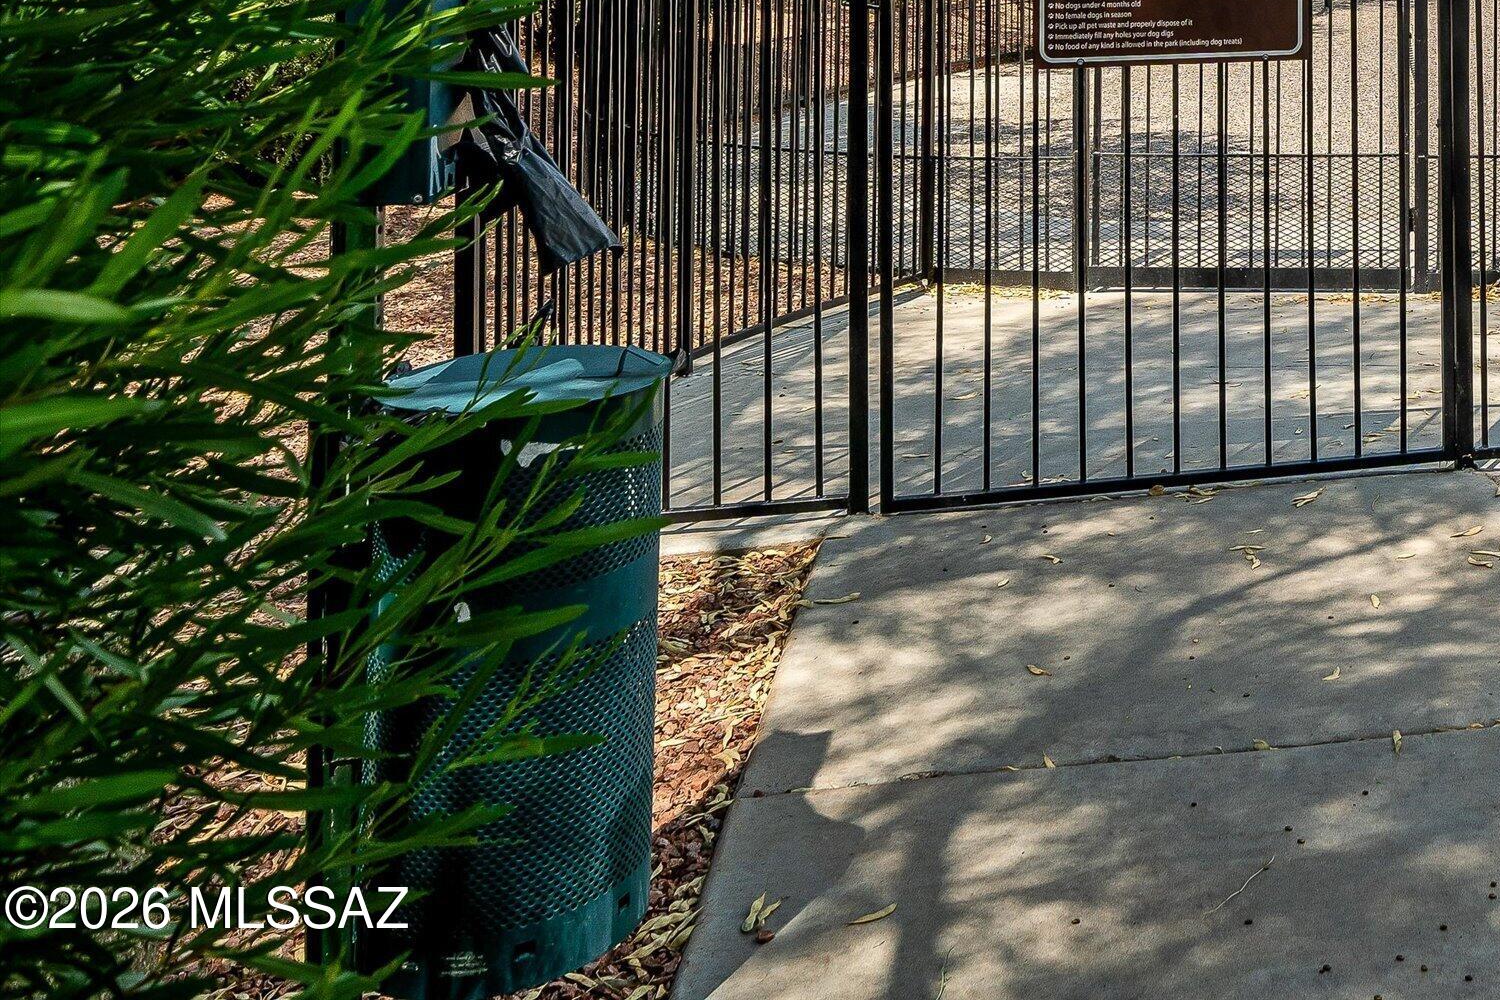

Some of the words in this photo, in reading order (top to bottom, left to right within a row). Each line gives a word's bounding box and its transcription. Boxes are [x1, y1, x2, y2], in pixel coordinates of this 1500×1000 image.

[1065, 2, 1081, 10] dogs
[1087, 11, 1103, 20] dogs
[1086, 22, 1098, 30] pet
[1130, 20, 1156, 29] properly
[1156, 19, 1180, 28] dispose
[1055, 32, 1094, 41] Immediately
[1147, 30, 1160, 39] dog
[1161, 29, 1174, 38] digs
[1164, 40, 1178, 49] park
[1210, 38, 1223, 47] dog
